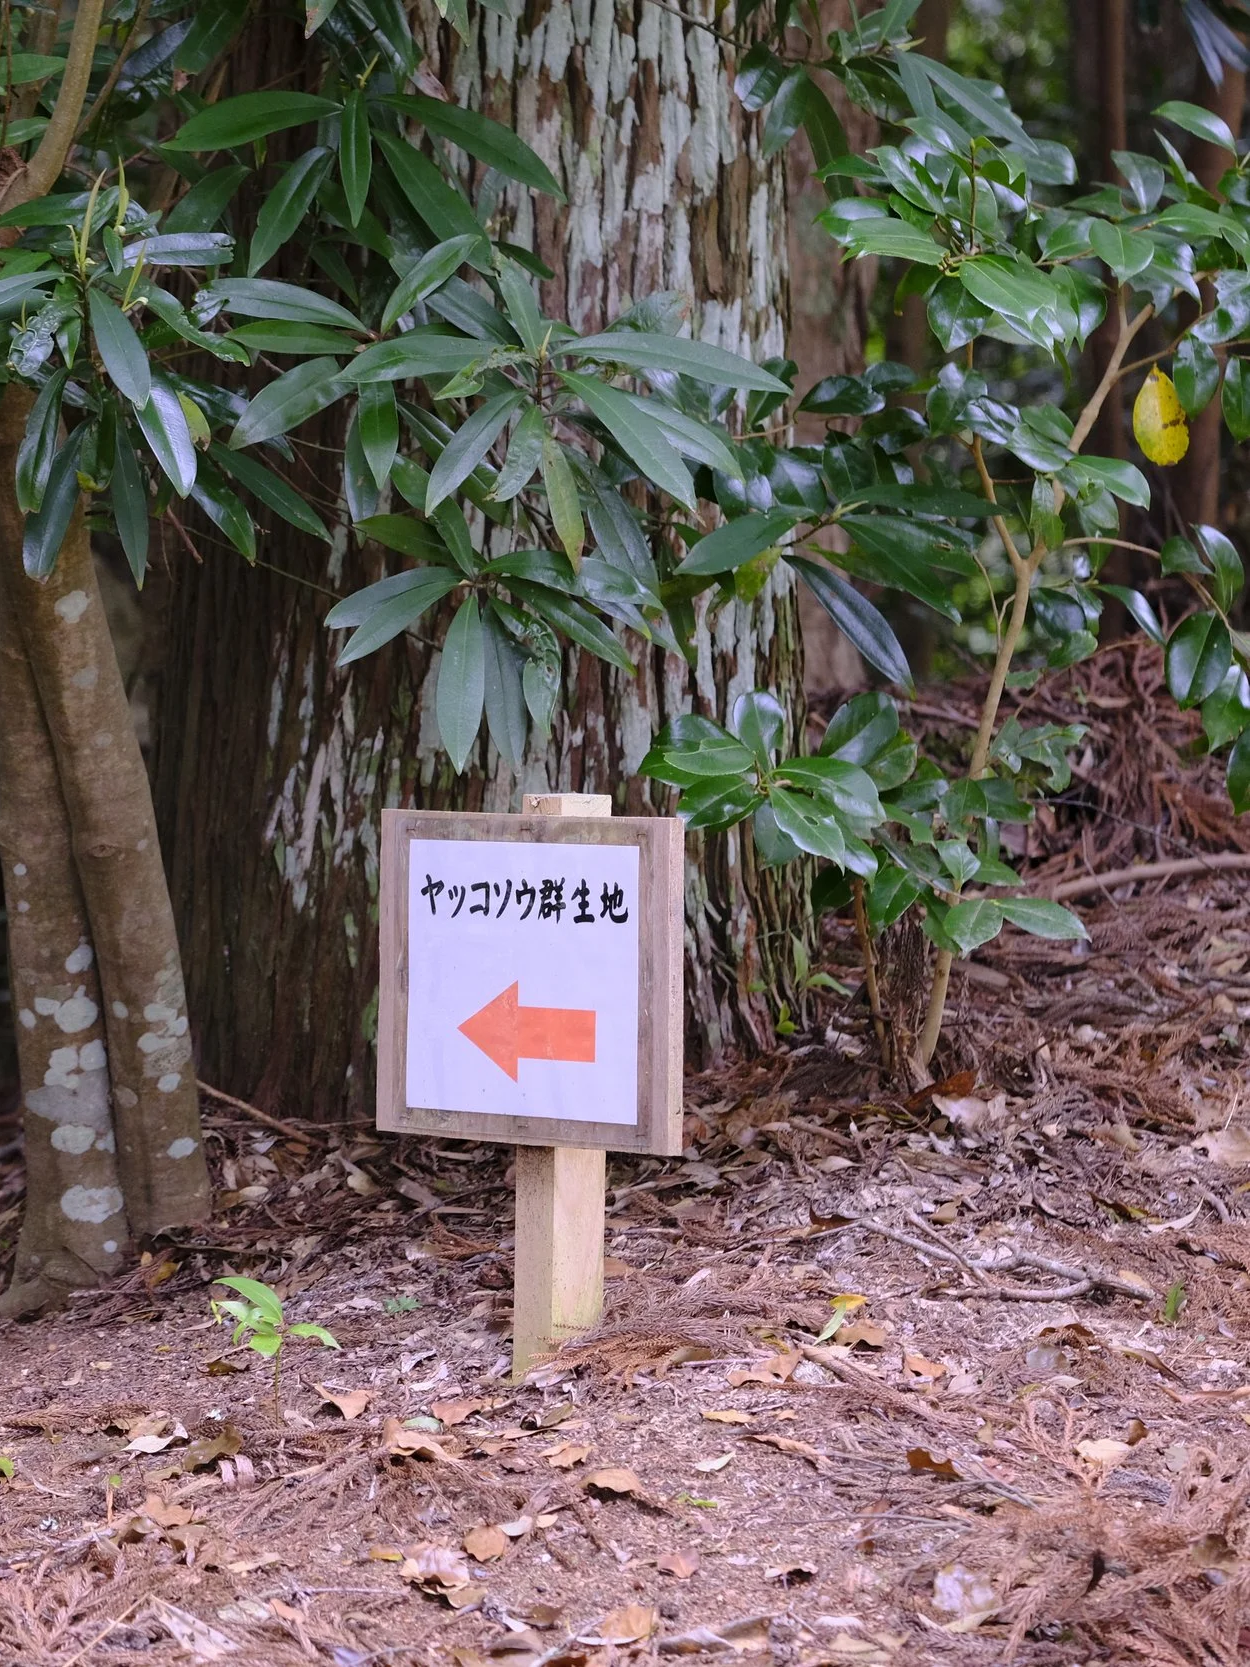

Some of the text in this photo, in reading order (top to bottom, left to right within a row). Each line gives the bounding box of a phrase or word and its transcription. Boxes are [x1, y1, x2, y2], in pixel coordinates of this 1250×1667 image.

[420, 873, 629, 924] ヤッコソウ群生地
